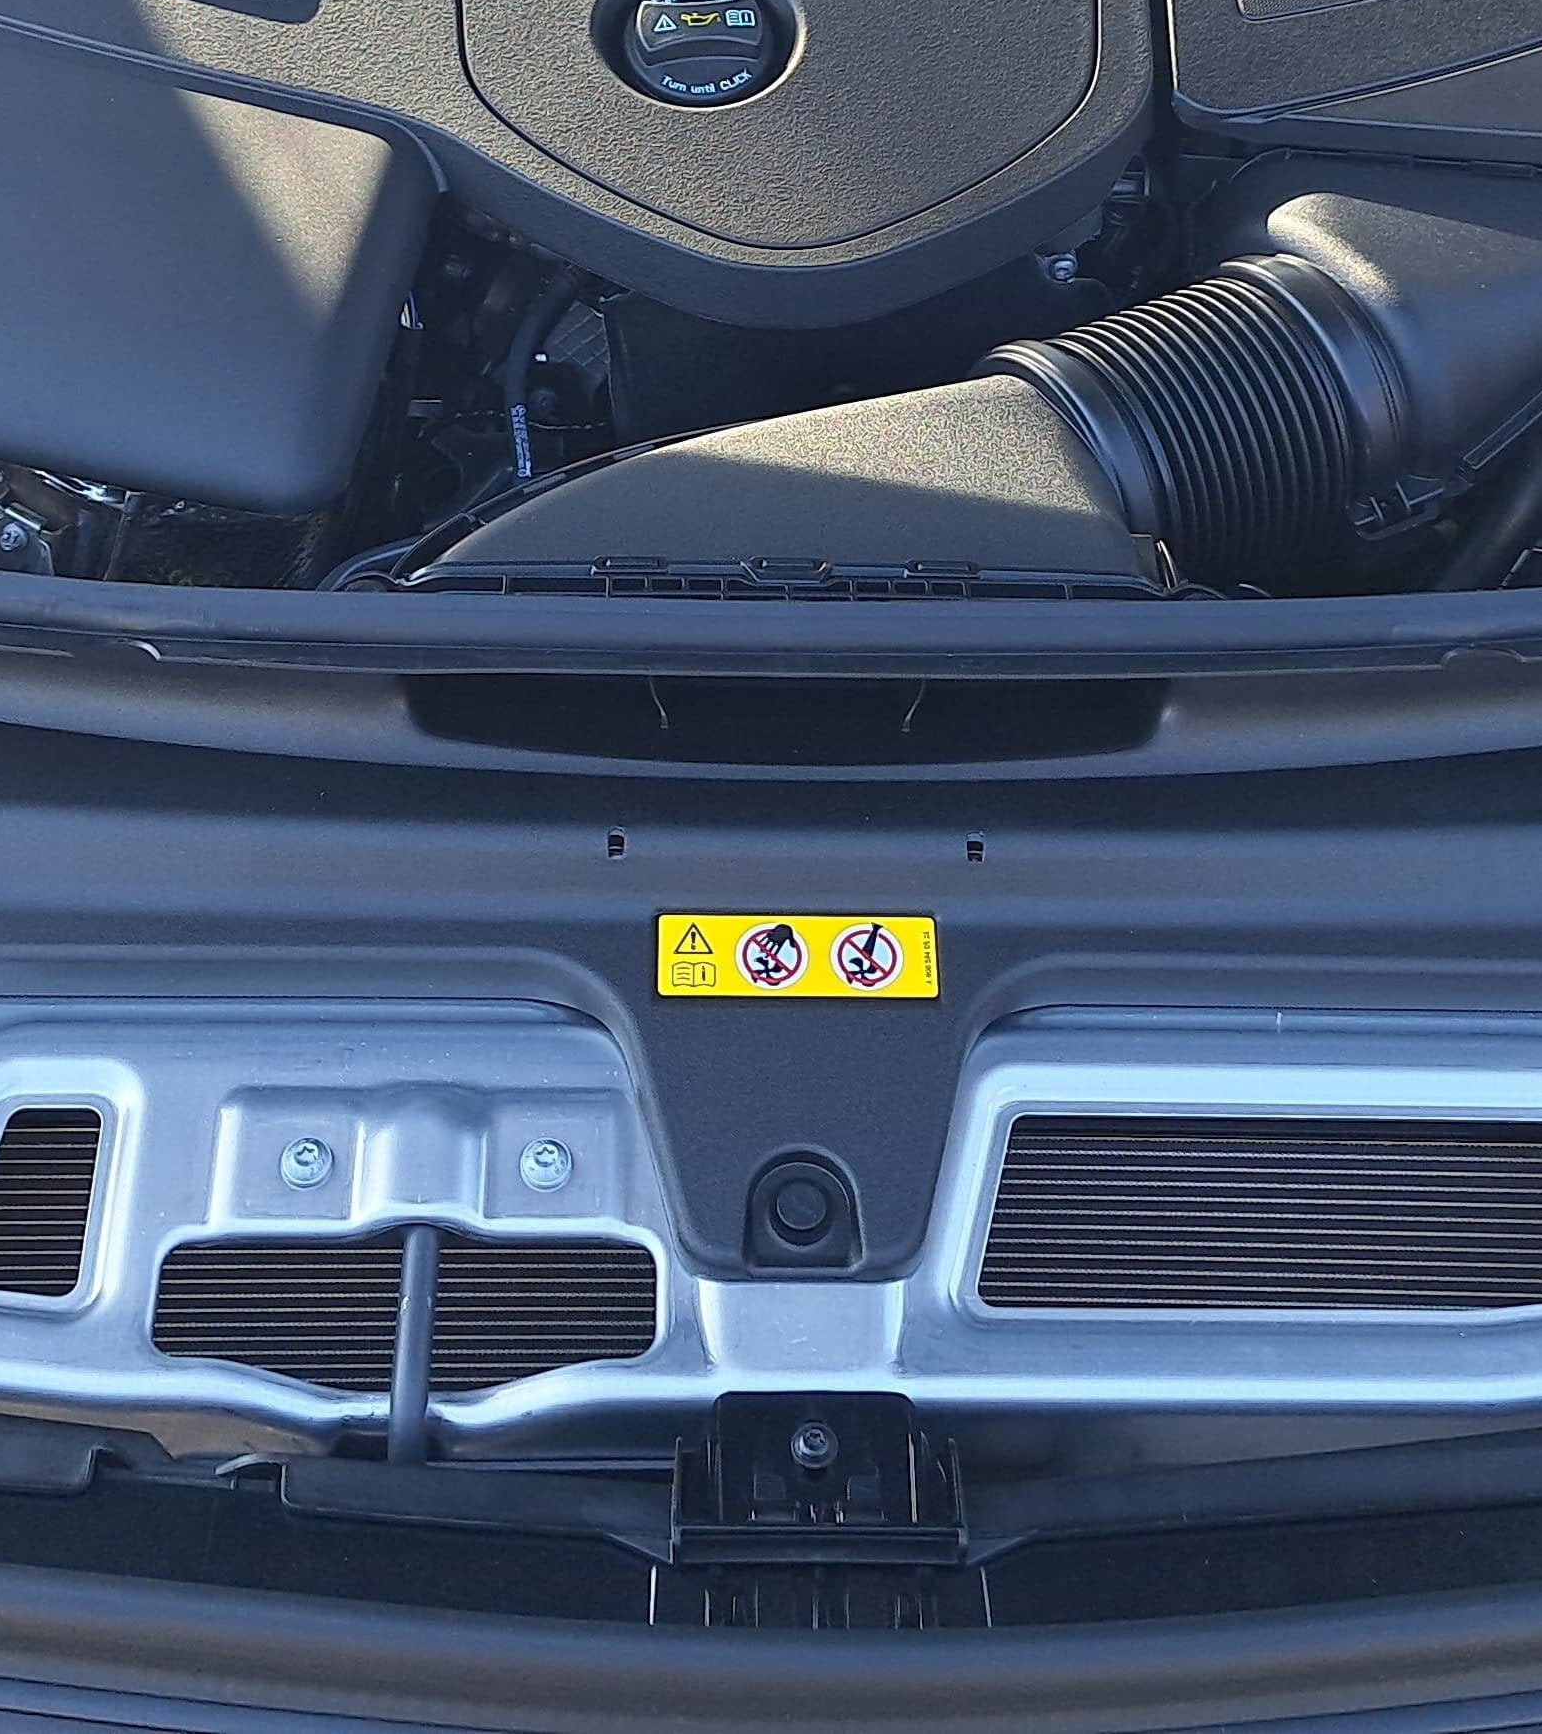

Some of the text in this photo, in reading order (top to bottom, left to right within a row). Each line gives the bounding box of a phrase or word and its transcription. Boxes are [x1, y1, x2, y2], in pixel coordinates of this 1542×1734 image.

[662, 67, 752, 94] Turn until CLICK
